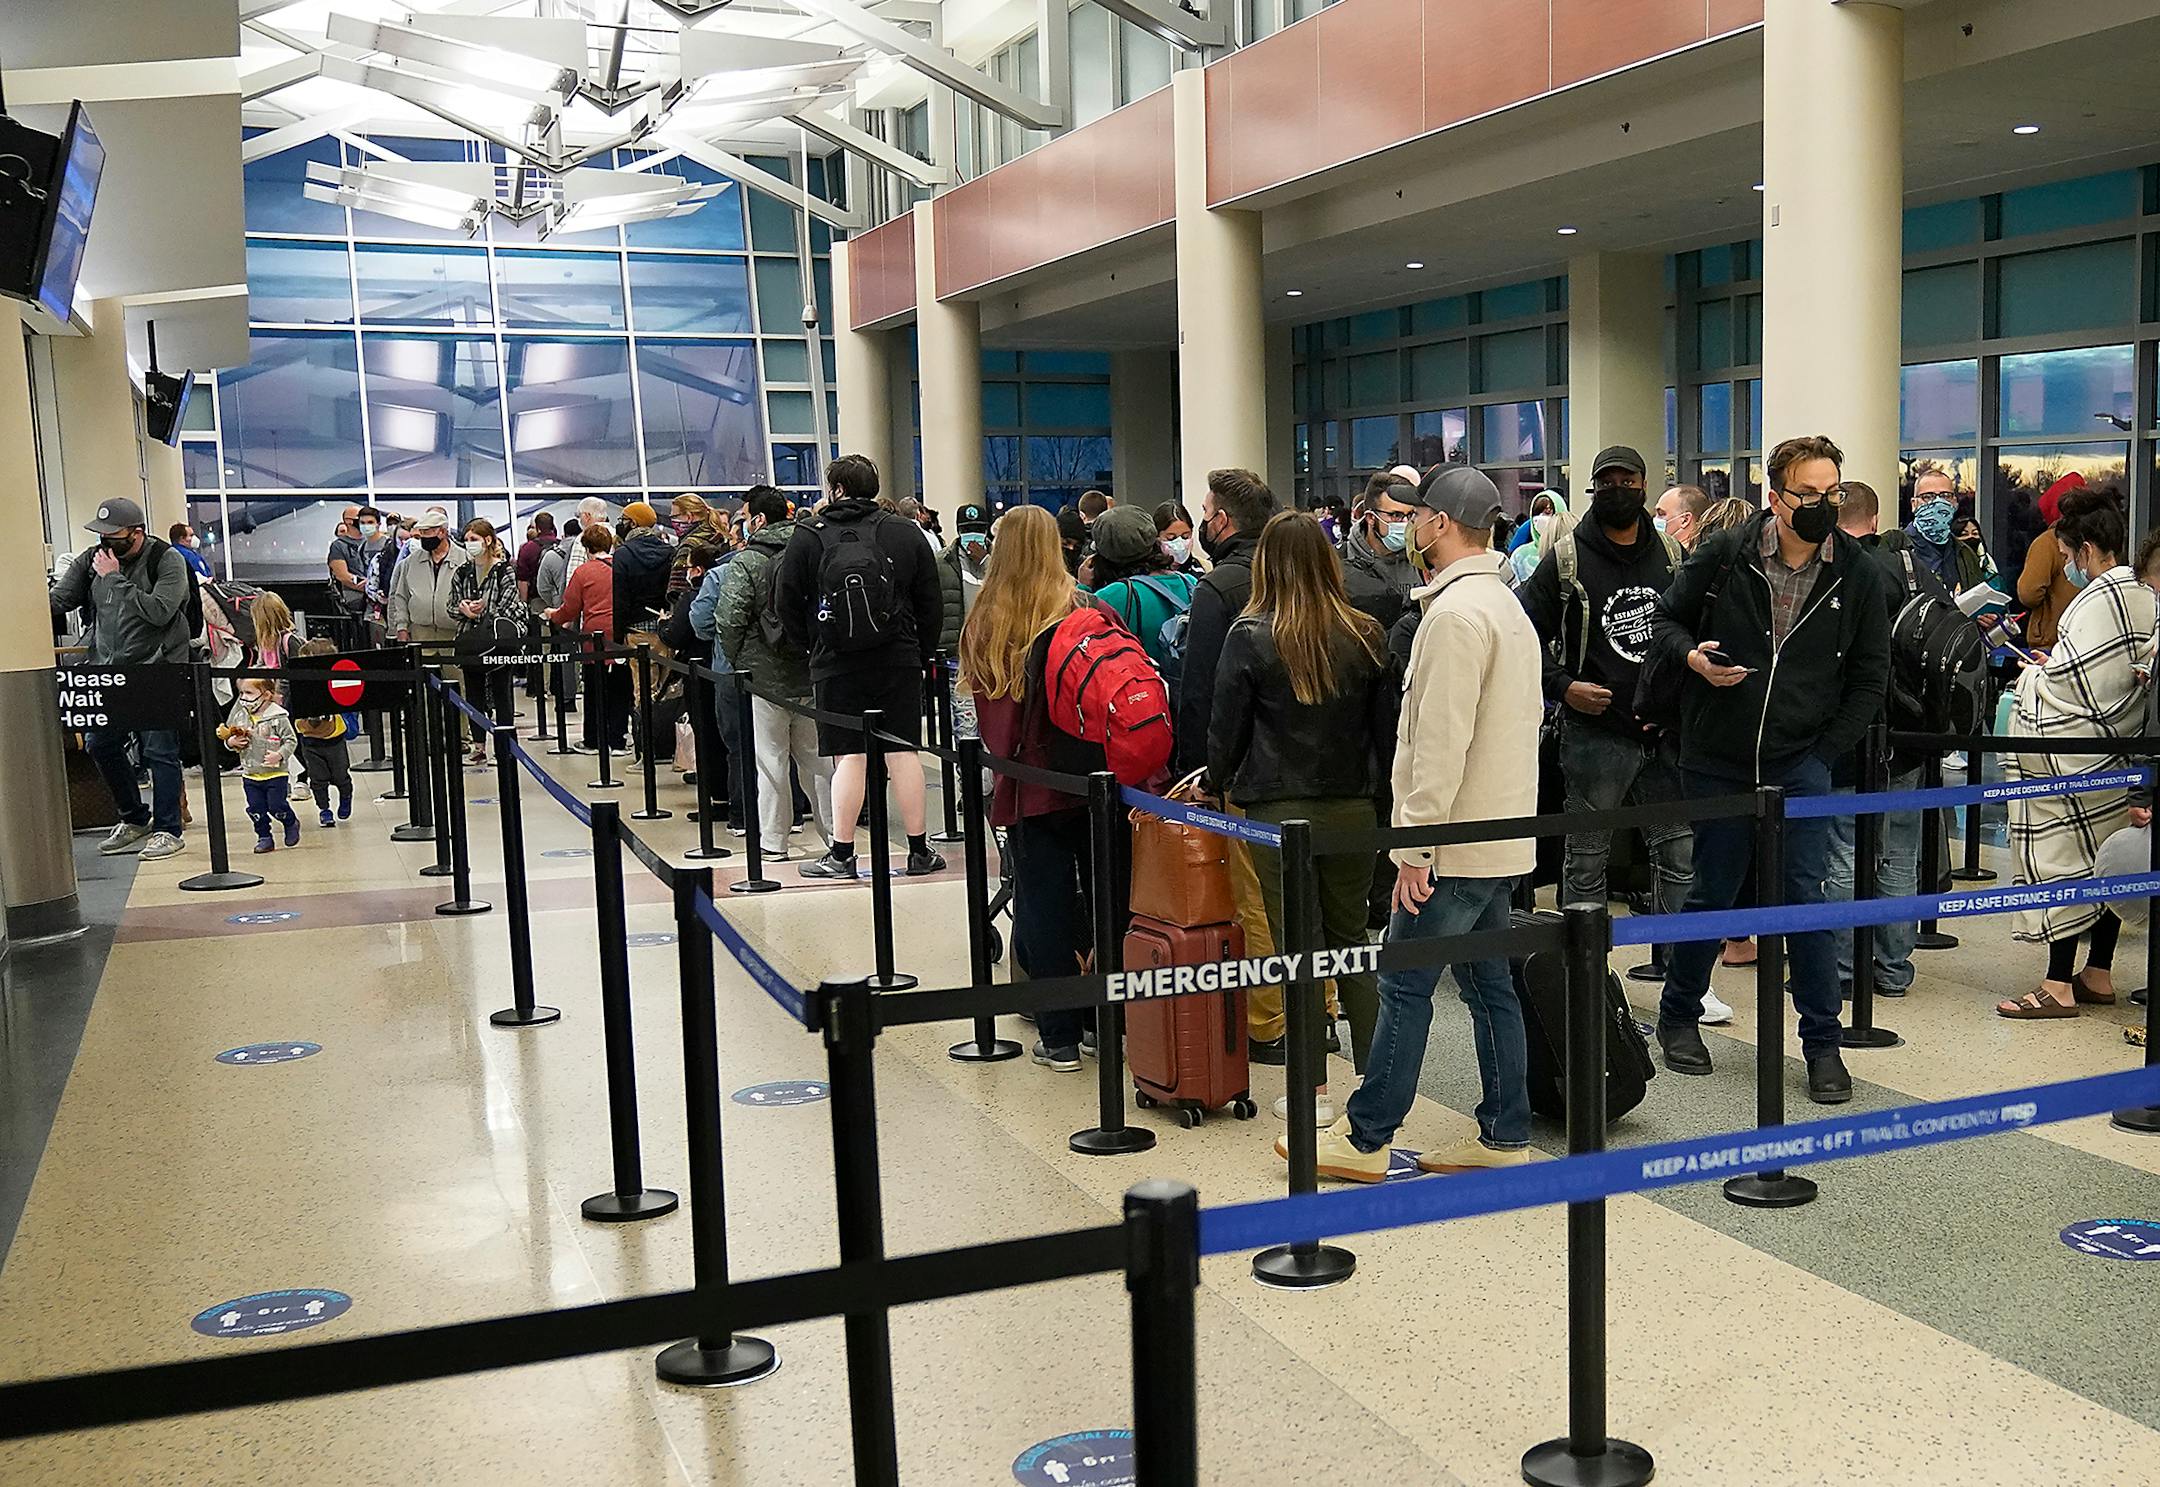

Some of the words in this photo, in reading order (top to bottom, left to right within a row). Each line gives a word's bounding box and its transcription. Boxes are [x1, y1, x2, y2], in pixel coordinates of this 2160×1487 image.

[482, 654, 544, 665] EMERGENCY
[546, 653, 571, 663] EXIT
[56, 671, 127, 687] Please
[1983, 788, 2000, 798] KEEP
[2005, 786, 2021, 796] SAFE
[2021, 783, 2051, 794] DISTANCE
[2058, 782, 2067, 790] FT
[1938, 901, 1966, 913] KEEP
[1966, 899, 1975, 911] A
[1975, 896, 2002, 910] SAFE
[2002, 891, 2050, 907] DISTANCE
[2056, 889, 2063, 901] 6
[2063, 888, 2077, 900] FT
[2082, 886, 2111, 897] TRAVEL
[1106, 953, 1303, 1001] EMERGENCY
[1311, 945, 1383, 978] EXIT
[1642, 1156, 1686, 1179] KEEP
[1685, 1154, 1699, 1173] A
[1699, 1147, 1740, 1171] SAFE
[1741, 1136, 1815, 1164] DISTANCE
[1834, 1129, 1854, 1150] FT
[1861, 1122, 1911, 1145] TRAVEL
[1912, 1107, 2000, 1137] CONFIDENTLY
